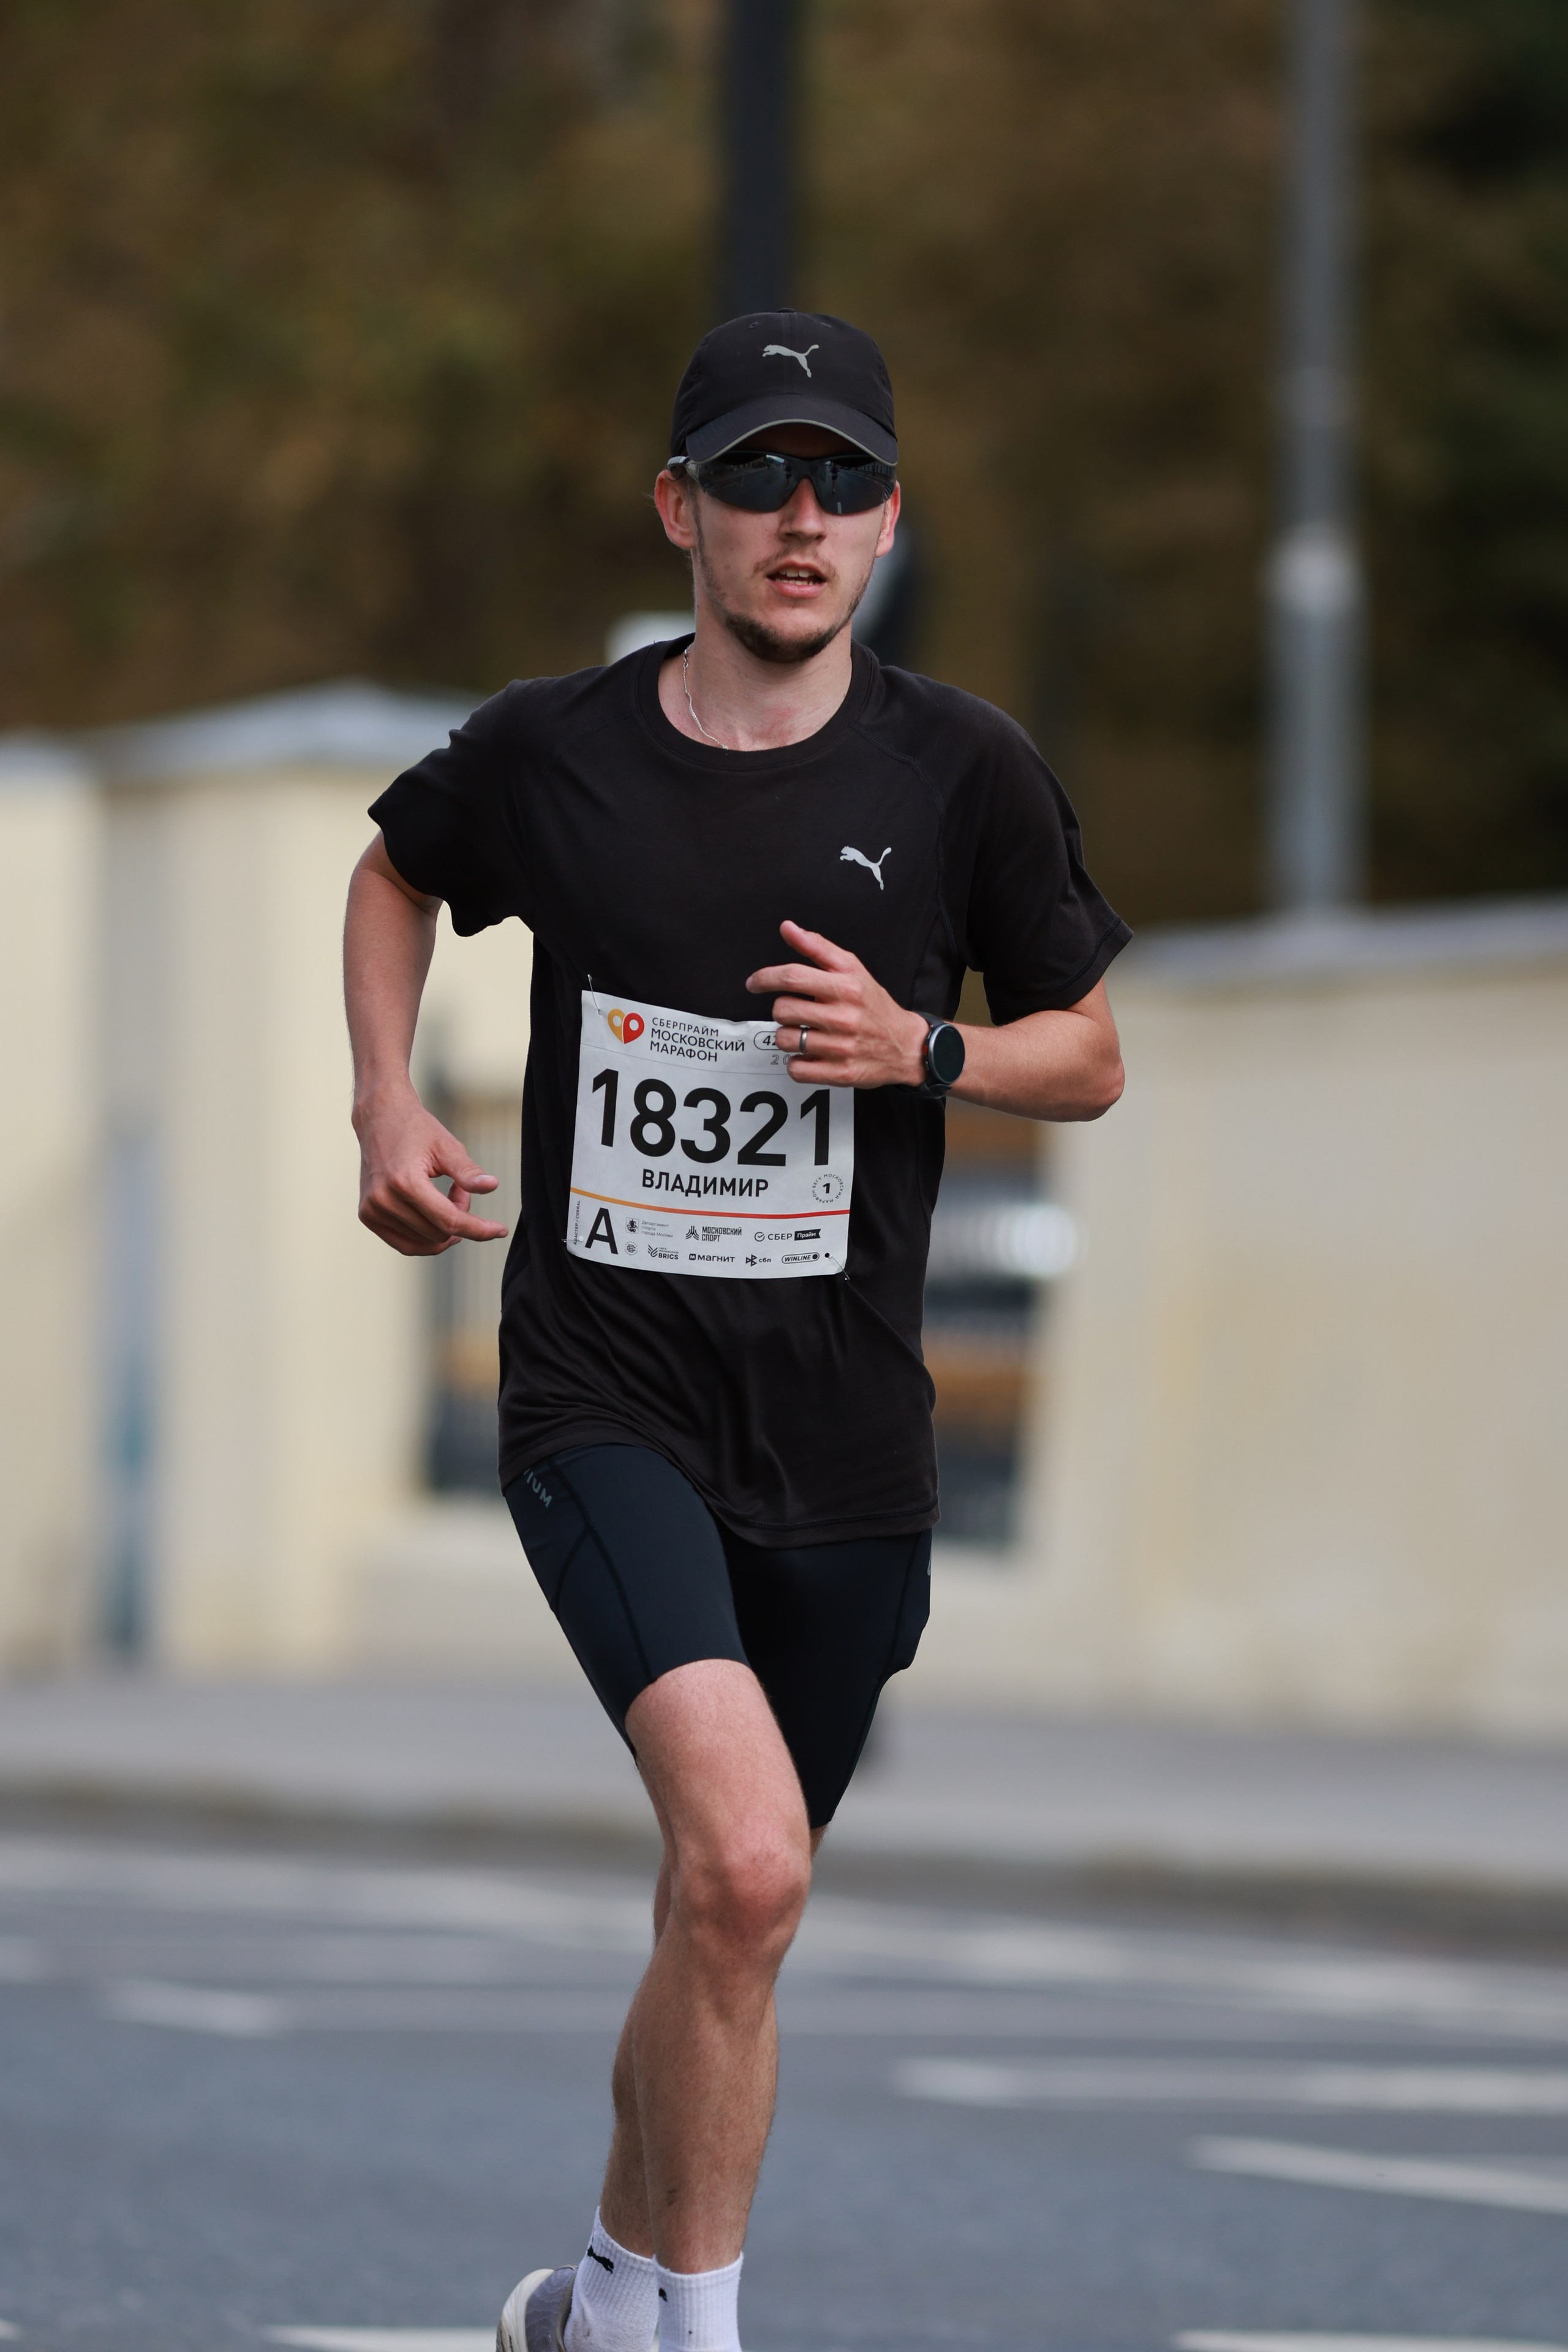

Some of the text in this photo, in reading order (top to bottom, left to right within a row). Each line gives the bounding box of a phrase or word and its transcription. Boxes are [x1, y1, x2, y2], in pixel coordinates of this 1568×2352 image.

[652, 1017, 719, 1037] СБЕРПРАЙМ
[651, 1028, 745, 1052] МОСКОВСКИЙ
[650, 1041, 718, 1062] МАРАФОН
[592, 1068, 830, 1167] 18321
[641, 1169, 769, 1197] ВЛАДИМИР
[823, 1183, 830, 1194] 1
[702, 1226, 742, 1235] МОСКОВСКИЙ
